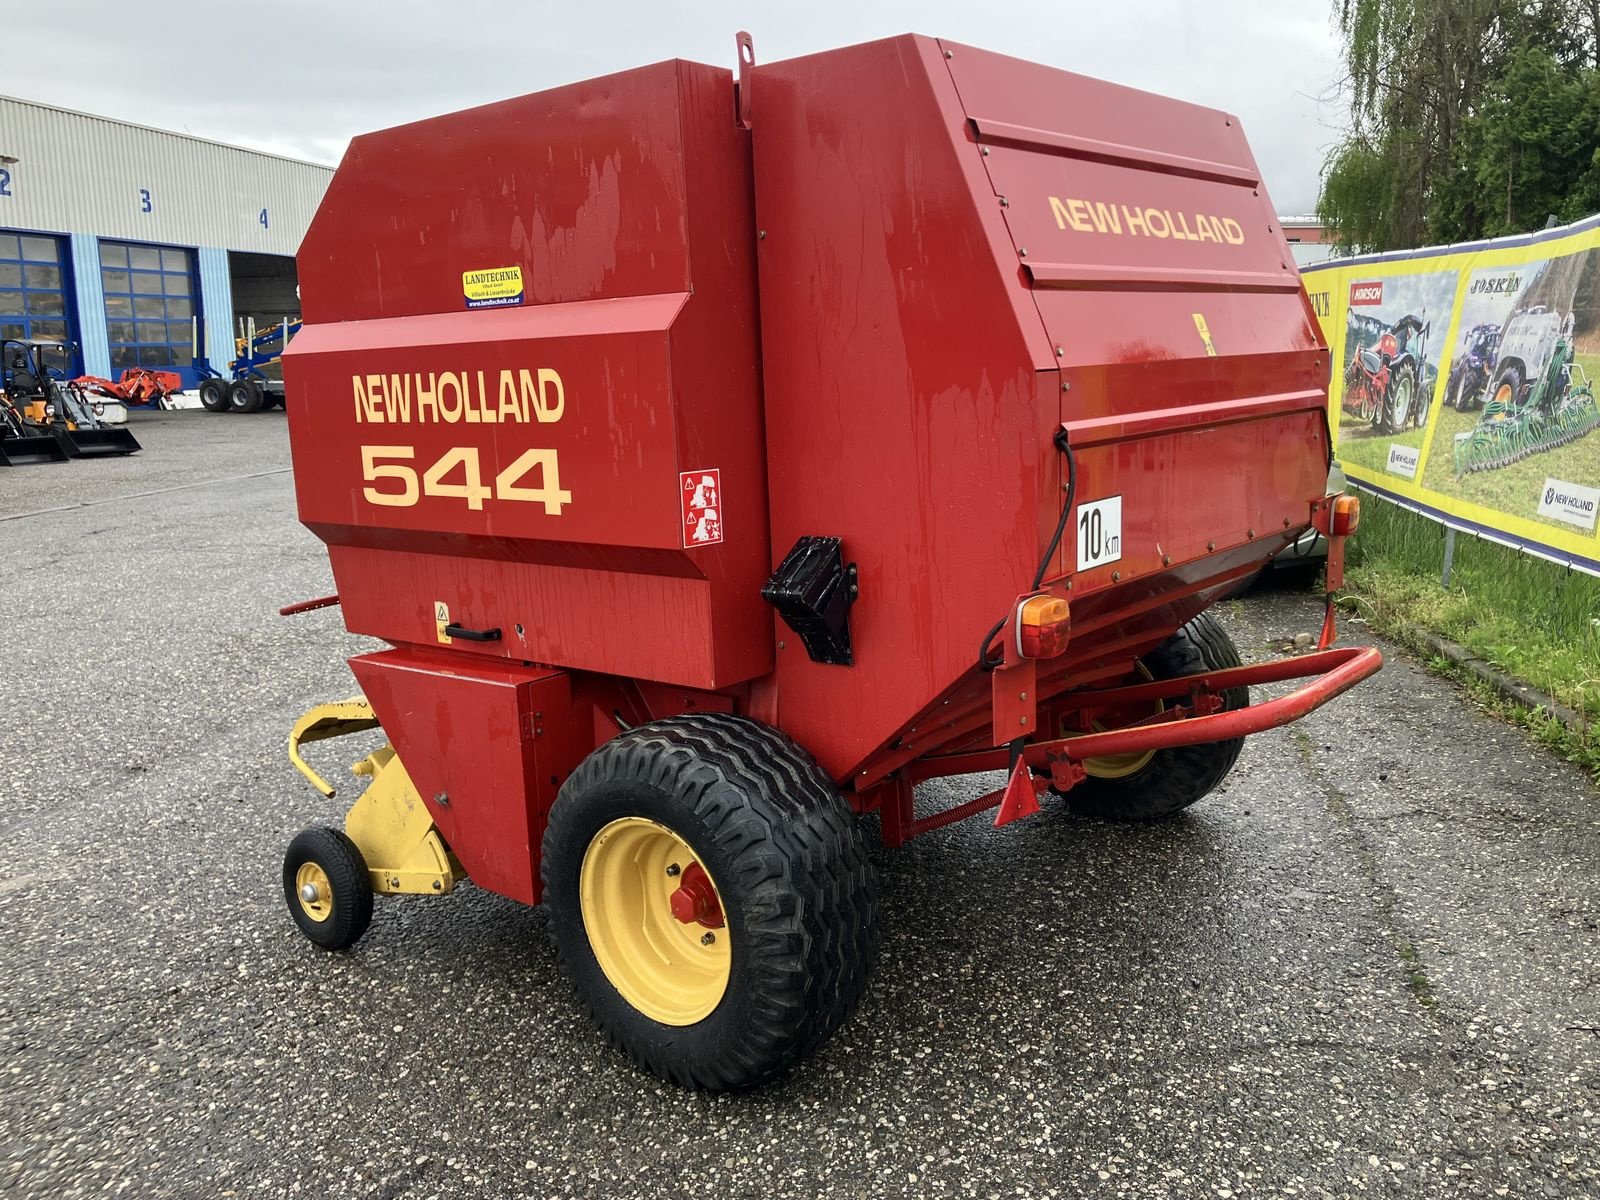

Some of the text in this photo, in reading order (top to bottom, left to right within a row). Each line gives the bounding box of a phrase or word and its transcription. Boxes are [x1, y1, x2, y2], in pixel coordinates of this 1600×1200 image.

[139, 188, 152, 213] 3
[259, 208, 269, 229] 4
[1048, 196, 1245, 246] NEW HOLLAND
[465, 270, 519, 284] LANDTECHNIK
[1470, 276, 1523, 295] JOSKIN
[1354, 287, 1382, 301] HORSCH
[352, 367, 565, 424] NEW HOLLAND
[360, 445, 572, 516] 544
[1554, 493, 1594, 512] NEW HOLLAND
[1080, 507, 1119, 562] 10 km
